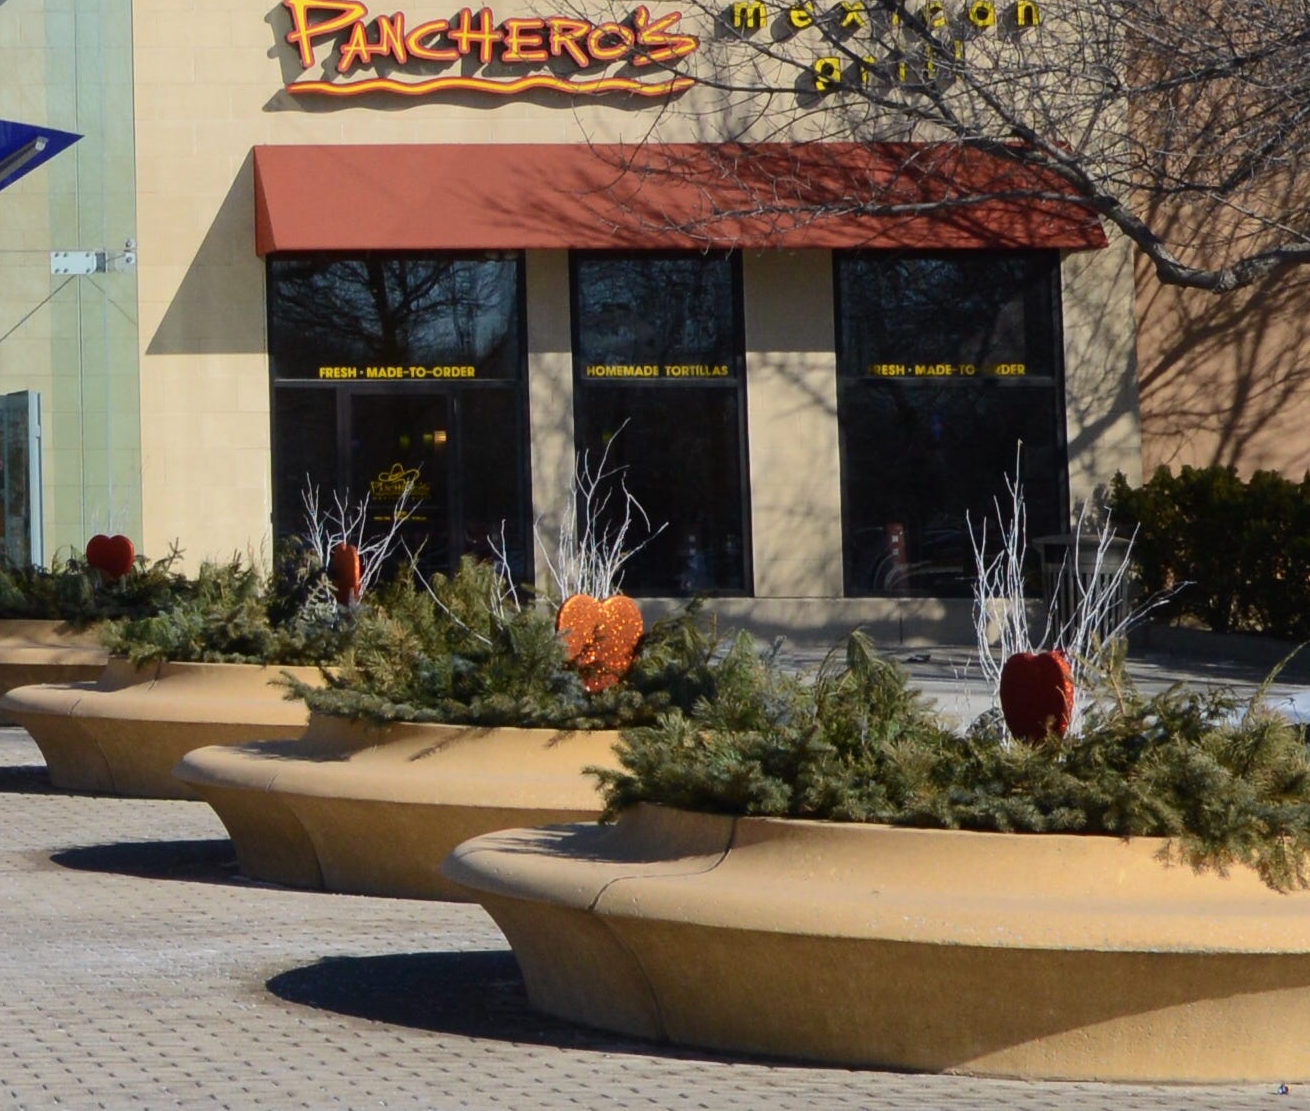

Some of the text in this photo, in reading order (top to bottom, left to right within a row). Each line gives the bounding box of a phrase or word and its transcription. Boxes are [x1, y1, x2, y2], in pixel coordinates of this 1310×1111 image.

[319, 366, 475, 379] FRESH MADE-TO-ORDER
[586, 365, 729, 377] HOMEMADE TORTILLAS
[868, 364, 905, 376] RESH
